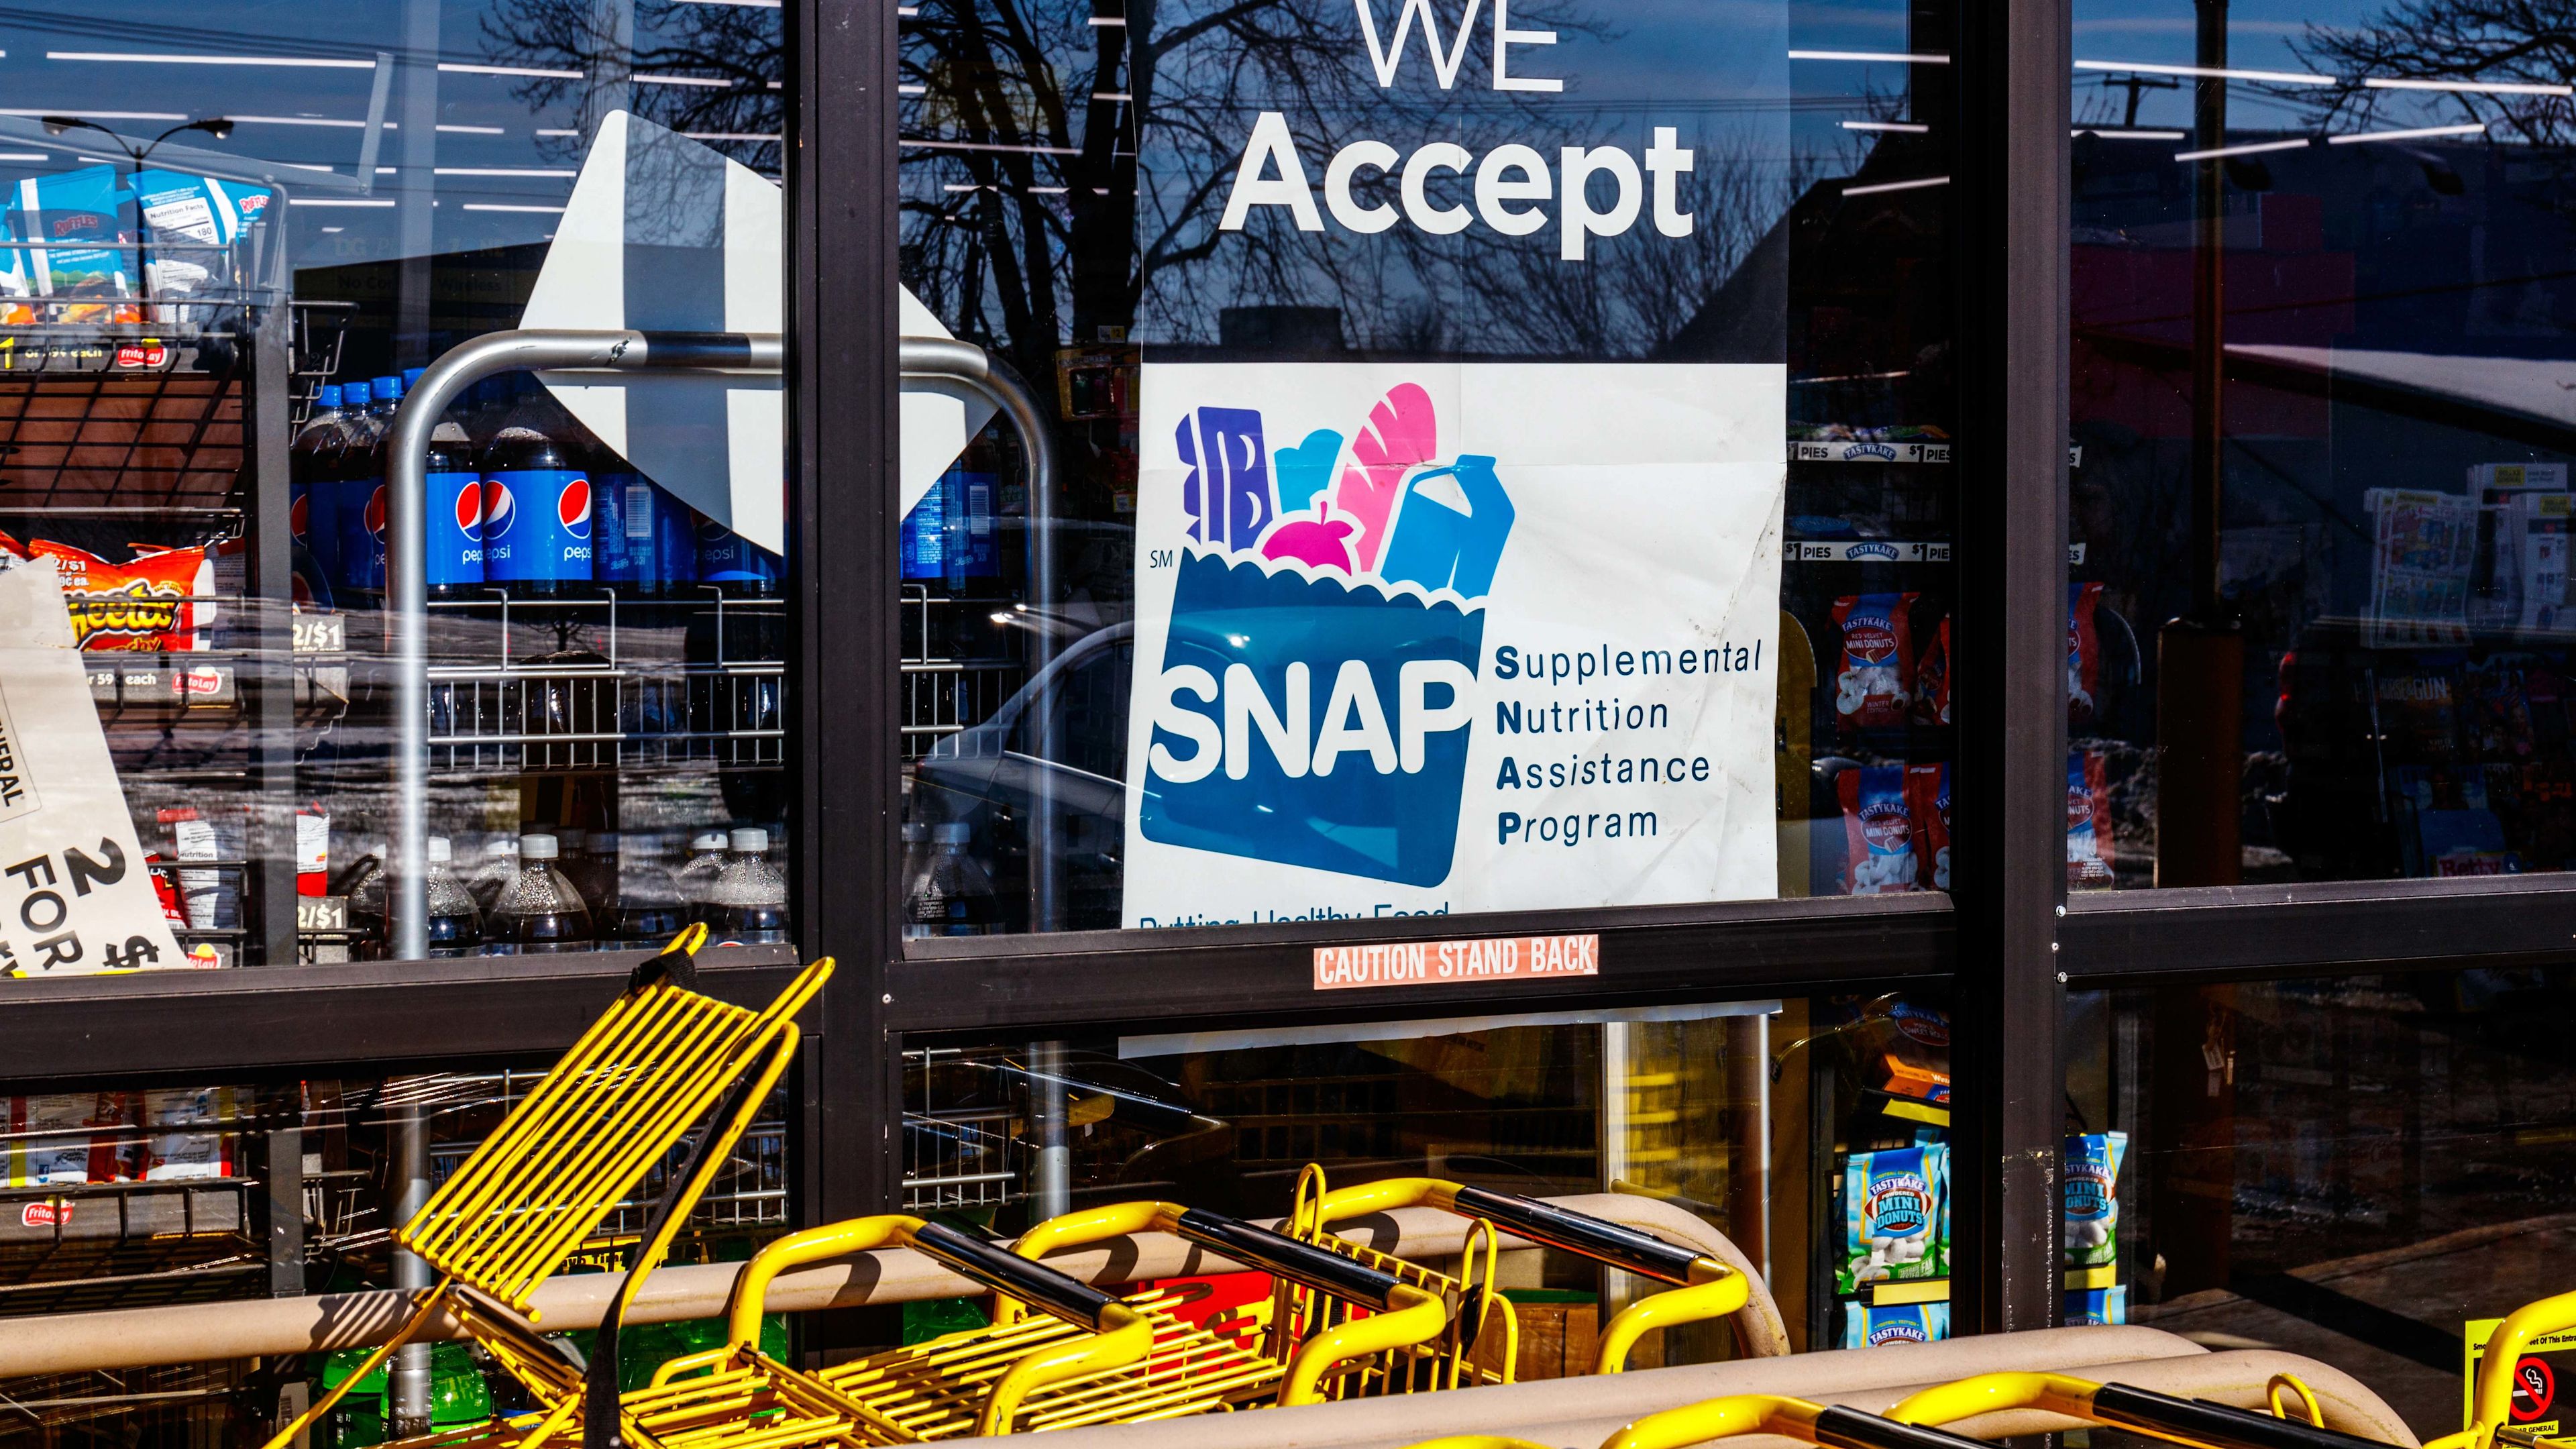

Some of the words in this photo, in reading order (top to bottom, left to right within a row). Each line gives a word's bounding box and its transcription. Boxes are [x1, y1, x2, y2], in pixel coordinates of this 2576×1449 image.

[1355, 0, 1564, 93] WE
[1218, 111, 1694, 261] Accept
[150, 206, 184, 220] Nutrition
[185, 203, 205, 212] Facts
[54, 215, 98, 237] RUFFLES
[197, 226, 213, 237] 180
[1801, 447, 1829, 458] PIES
[1844, 442, 1897, 461] TASTYKAKE
[1909, 444, 1925, 463] $1
[485, 544, 511, 559] epsi
[564, 545, 592, 562] peps
[1150, 549, 1173, 569] SM
[1786, 543, 1801, 561] $1
[1804, 547, 1831, 558] PIES
[1846, 542, 1900, 561] TASTYKAKE
[1912, 543, 1927, 561] $1
[1930, 547, 1951, 559] PIE
[1841, 616, 1893, 633] TASTYKAKE
[292, 621, 340, 648] 2/$1
[1845, 639, 1864, 649] MINI
[1865, 638, 1894, 649] DONUTS
[1495, 639, 1762, 686] Supplemental
[125, 673, 156, 685] each
[1148, 659, 1477, 784] SNAP
[1497, 698, 1668, 735] Nutrition
[1496, 753, 1710, 790] Assistance
[1858, 803, 1910, 820] TASTYKAKE
[2068, 804, 2091, 815] NUTS
[1498, 812, 1657, 847] Program
[1866, 826, 1882, 838] MINI
[1882, 824, 1911, 836] DONUTS
[62, 837, 127, 898] 2
[5, 853, 84, 971] FOR
[298, 904, 343, 930] 2/$1
[1319, 944, 1426, 984] CAUTION
[1438, 940, 1518, 977] STAND
[1530, 936, 1595, 972] BACK
[1870, 1177, 1925, 1196] TASTYKAKE
[1881, 1190, 1915, 1200] POWDERED
[1878, 1196, 1921, 1214] MINI
[1876, 1210, 1924, 1230] DONUTS
[1870, 1327, 1925, 1344] TASTYKAKE
[2540, 1336, 2547, 1345] Of
[2548, 1336, 2561, 1344] This
[2562, 1334, 2576, 1342] Entra
[2528, 1424, 2555, 1433] GENERAL
